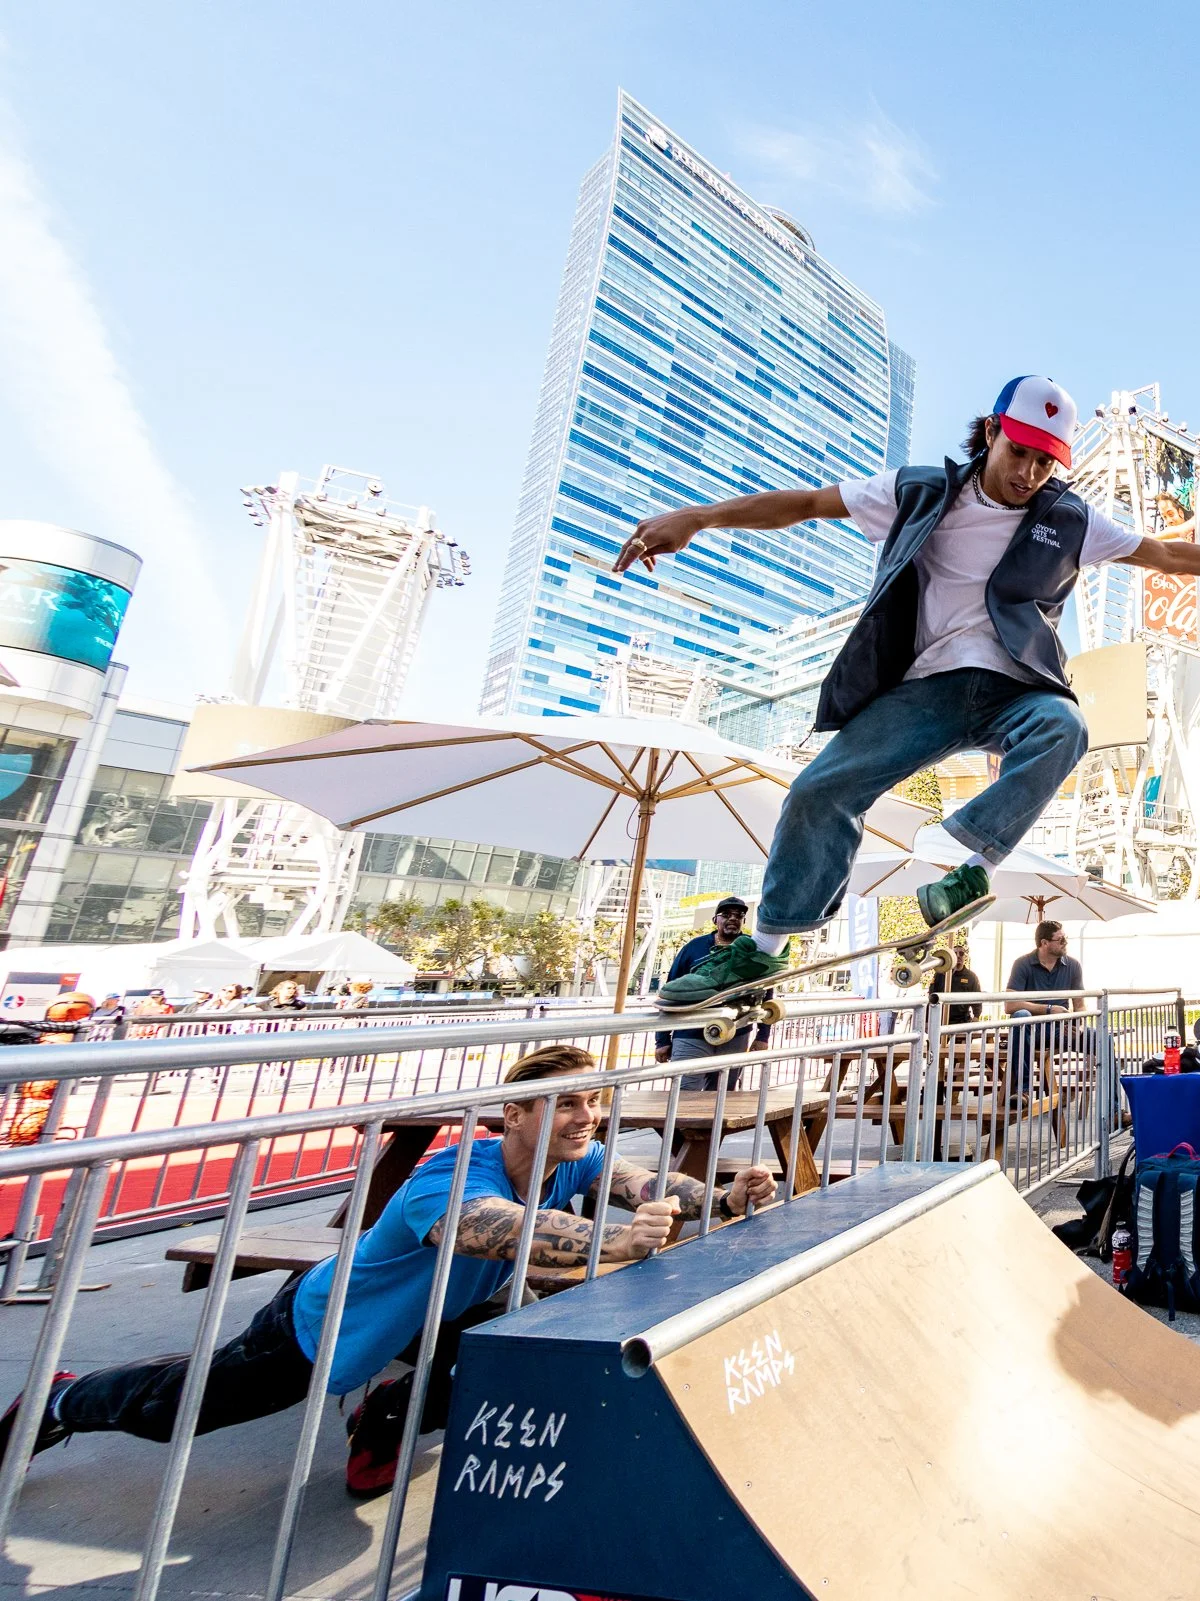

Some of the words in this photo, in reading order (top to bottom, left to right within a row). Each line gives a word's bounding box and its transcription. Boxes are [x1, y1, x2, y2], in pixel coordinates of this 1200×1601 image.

[1032, 533, 1061, 548] FESTIVAL
[854, 898, 874, 990] CLINCS
[464, 1400, 567, 1449] KEEN
[453, 1453, 567, 1502] RAMPS
